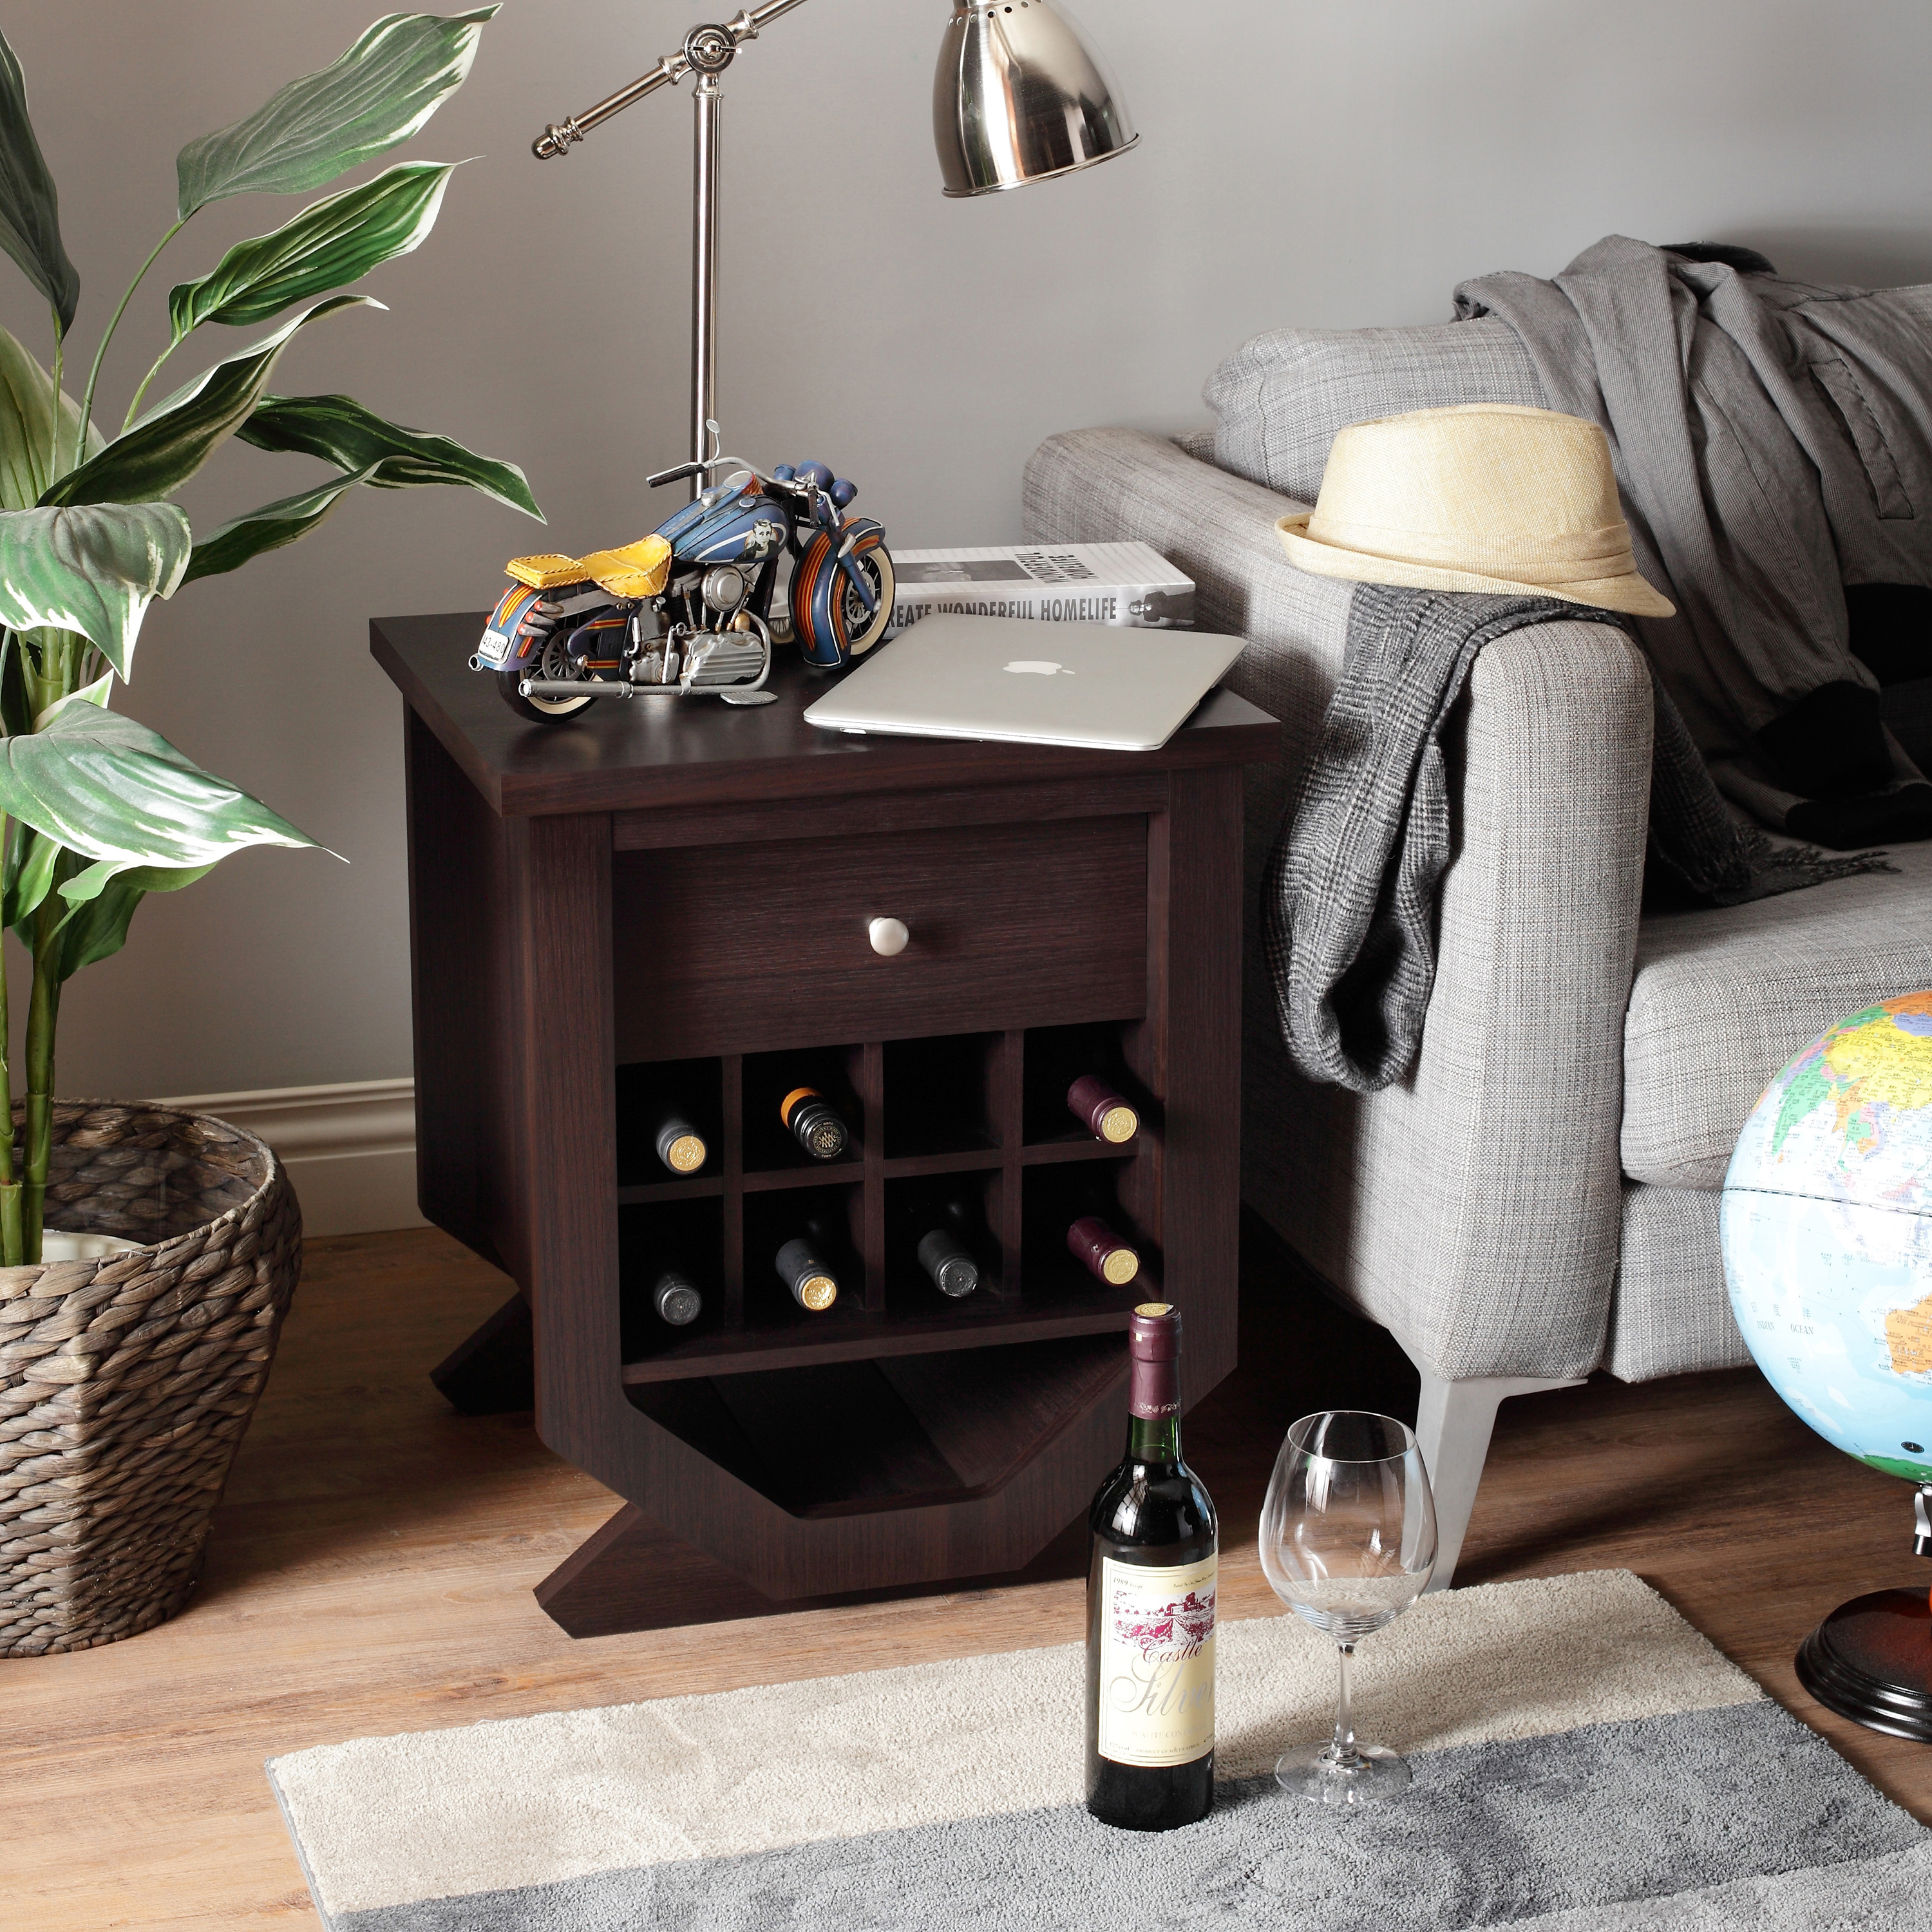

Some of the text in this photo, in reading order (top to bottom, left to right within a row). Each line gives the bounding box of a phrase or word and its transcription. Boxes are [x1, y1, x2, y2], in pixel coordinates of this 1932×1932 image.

[1014, 552, 1070, 583] WONDERFUL
[1048, 554, 1099, 580] HOMELIFE
[888, 603, 932, 627] REAT
[1041, 597, 1116, 621] HOMELIFE
[1756, 1320, 1814, 1334] INDIAN OCEAN
[1113, 1577, 1128, 1586] 1989
[1139, 1634, 1202, 1665] Castle
